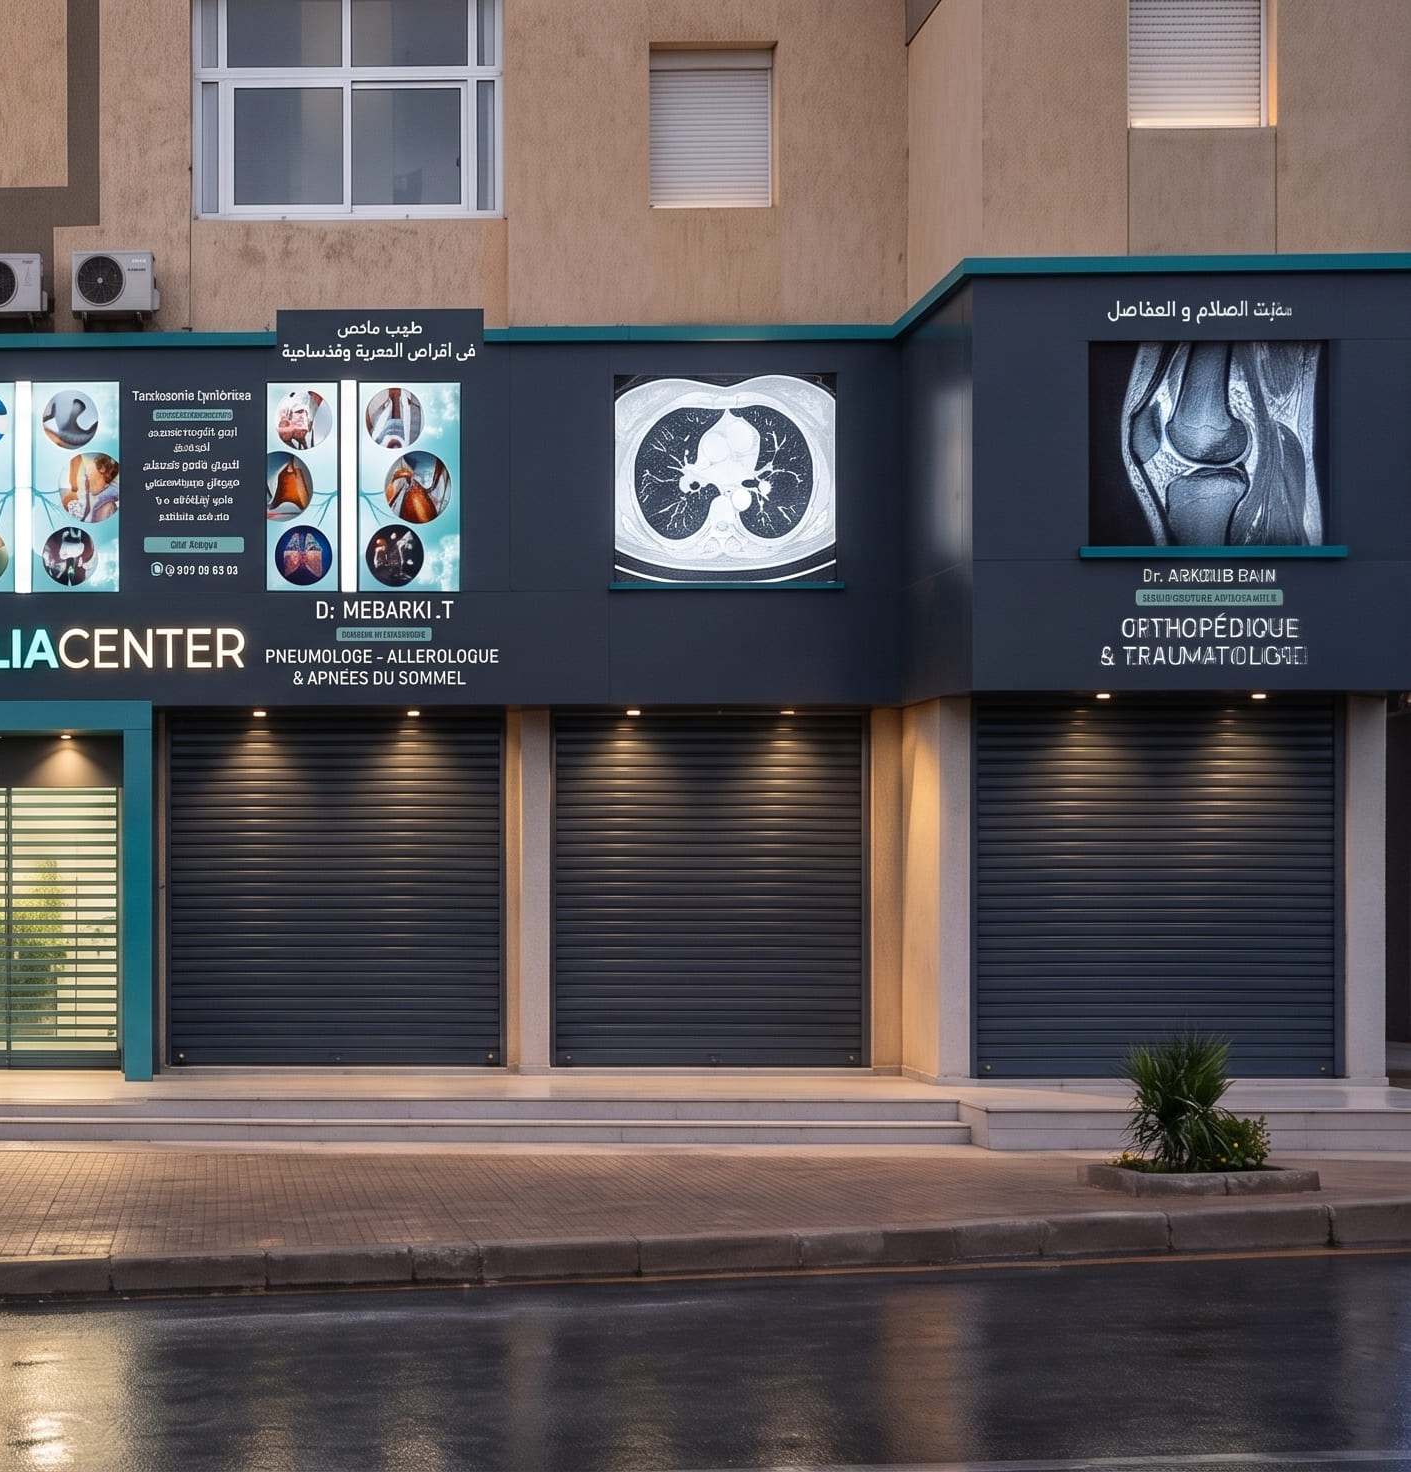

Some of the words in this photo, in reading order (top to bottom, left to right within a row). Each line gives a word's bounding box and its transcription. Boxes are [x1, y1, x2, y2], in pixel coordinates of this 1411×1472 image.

[1144, 569, 1163, 582] Dr.
[266, 649, 372, 663] PNEUMOLOGE
[387, 649, 499, 663] ALLEROLOGUE
[1101, 646, 1115, 665] &
[293, 671, 303, 685] &
[307, 669, 368, 685] APNÉES
[374, 671, 393, 685] DU
[399, 671, 466, 685] SOMMEL
